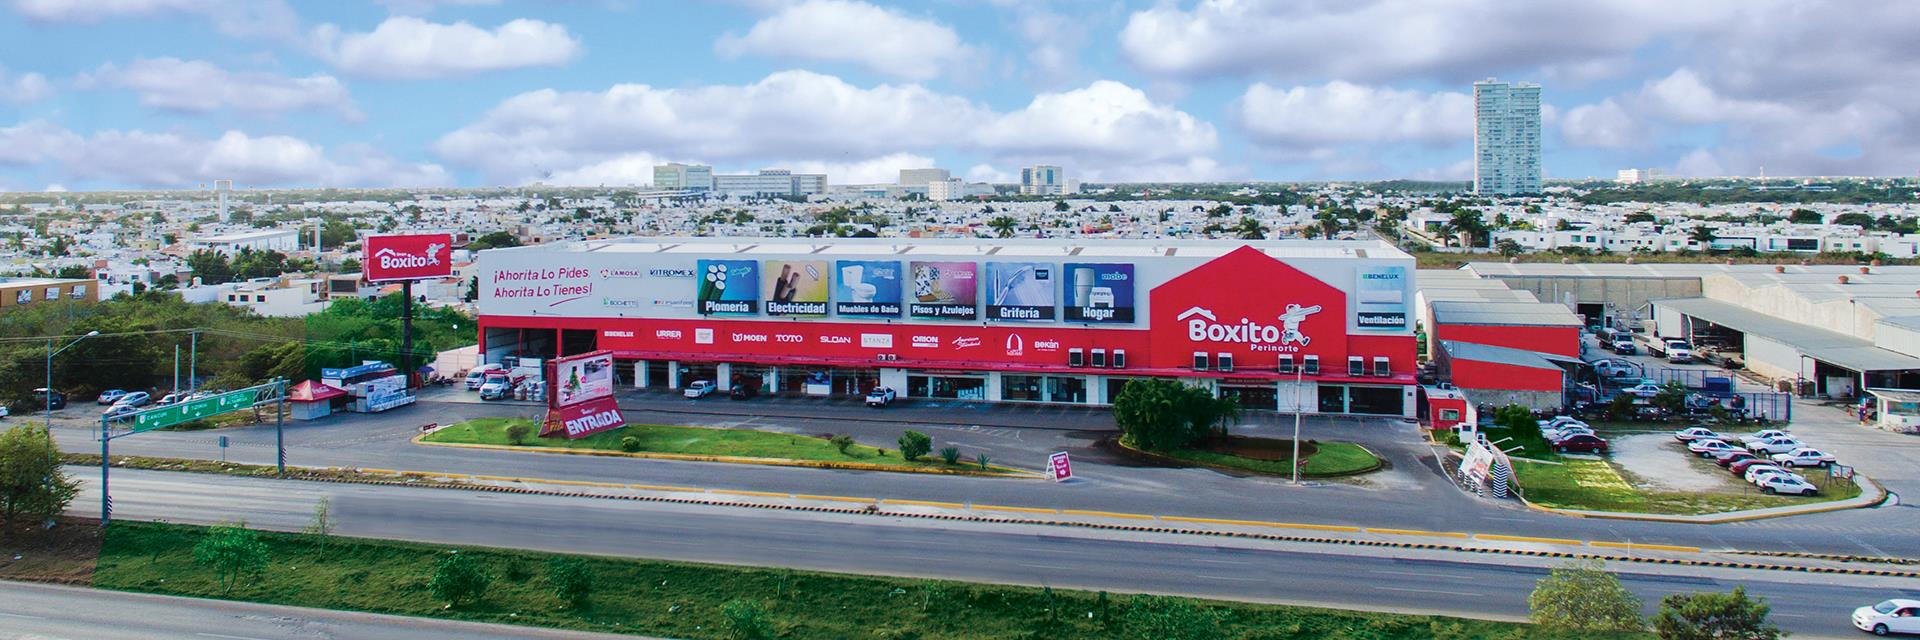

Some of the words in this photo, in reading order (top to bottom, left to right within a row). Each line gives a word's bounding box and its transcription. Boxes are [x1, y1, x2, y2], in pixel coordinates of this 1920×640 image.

[381, 253, 426, 269] Boxito
[494, 269, 539, 284] ¡Ahorita
[541, 268, 555, 280] Lo
[558, 267, 589, 279] Pides
[649, 269, 694, 277] VITROMEX
[494, 286, 534, 298] Ahorita
[537, 286, 550, 297] Lo
[553, 282, 593, 296] Tienes!
[705, 301, 749, 312] Plomería
[768, 302, 825, 313] Electricidad
[839, 305, 869, 313] Muebles
[870, 305, 880, 313] de
[881, 304, 899, 313] Baño
[912, 305, 933, 314] Pisos
[934, 307, 940, 316] y
[941, 306, 974, 316] Azulejos
[1000, 307, 1040, 318] Grifería
[1083, 307, 1115, 320] Hogar
[1358, 315, 1405, 324] Ventilación
[1188, 317, 1280, 344] Boxito
[743, 334, 768, 342] MOEN
[775, 334, 803, 343] TOTO
[819, 335, 851, 344] SLOAN
[1250, 343, 1299, 352] Perinorte
[565, 409, 622, 435] ENTRADA
